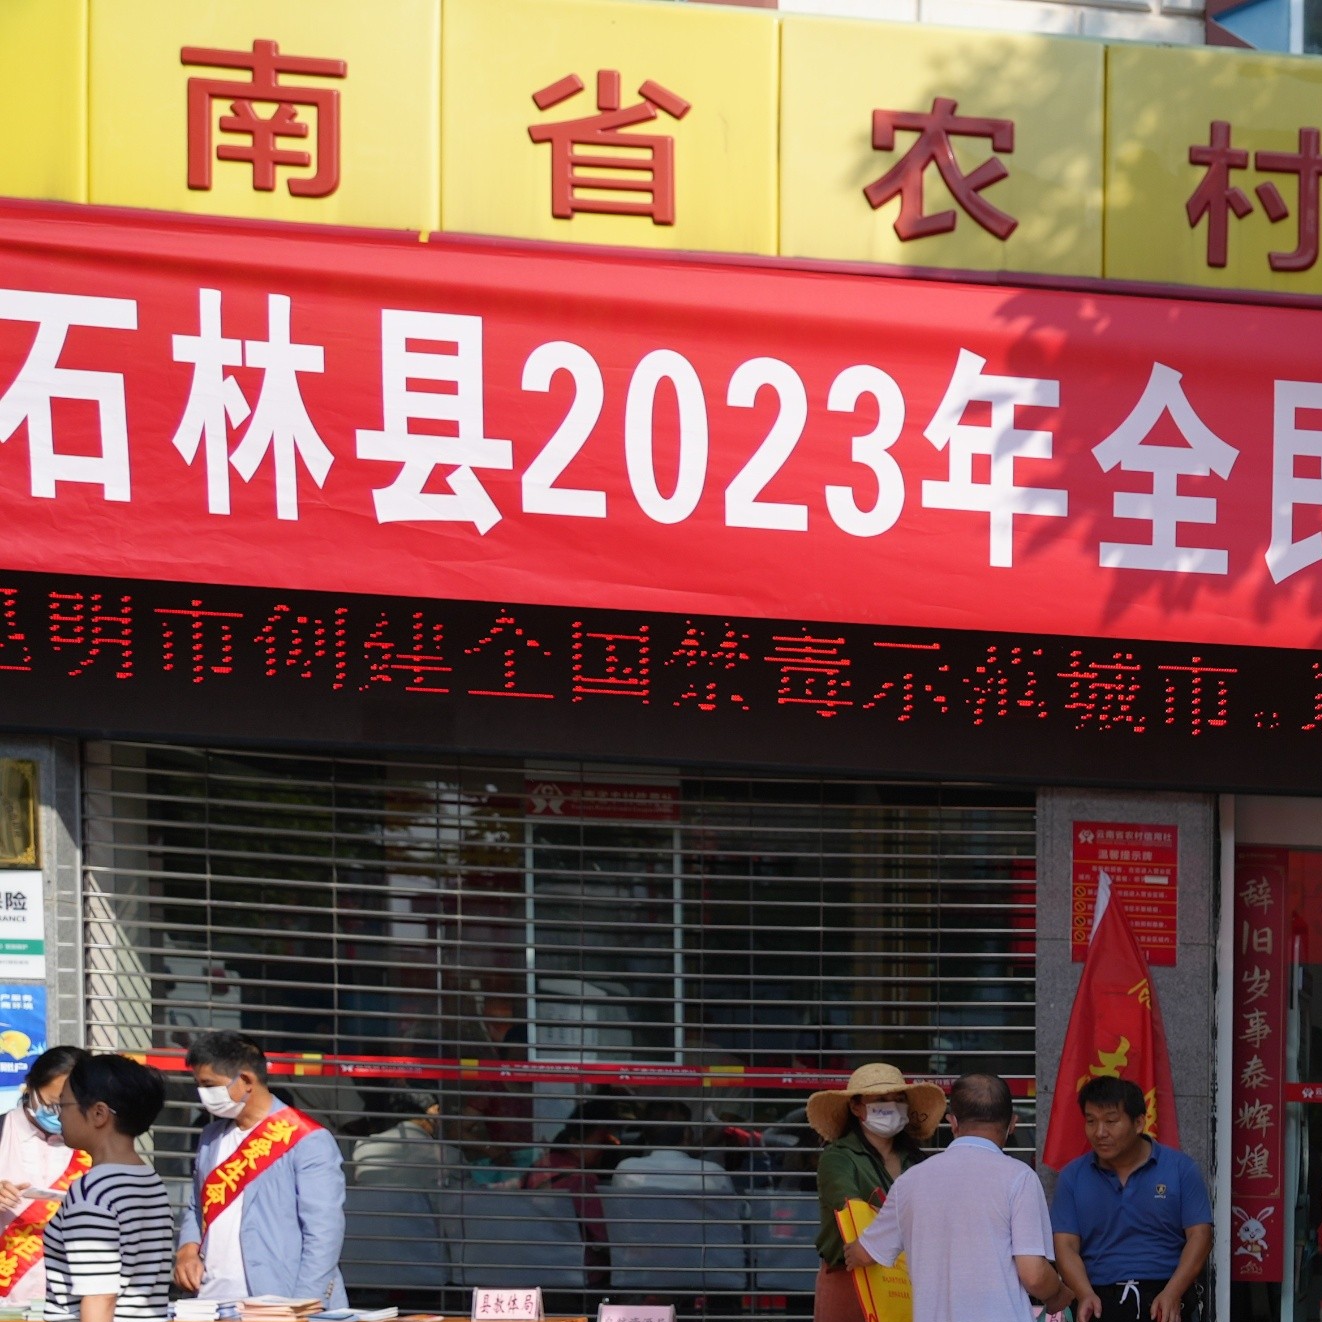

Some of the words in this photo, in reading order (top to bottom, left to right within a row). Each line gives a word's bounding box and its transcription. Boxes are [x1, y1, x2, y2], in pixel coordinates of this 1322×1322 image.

[1096, 829, 1173, 843] 云南省农村信用社
[1234, 876, 1275, 1180] 辞旧岁事泰辉煌
[205, 1119, 298, 1206] 珍爱生命
[479, 1293, 534, 1315] 县教体局
